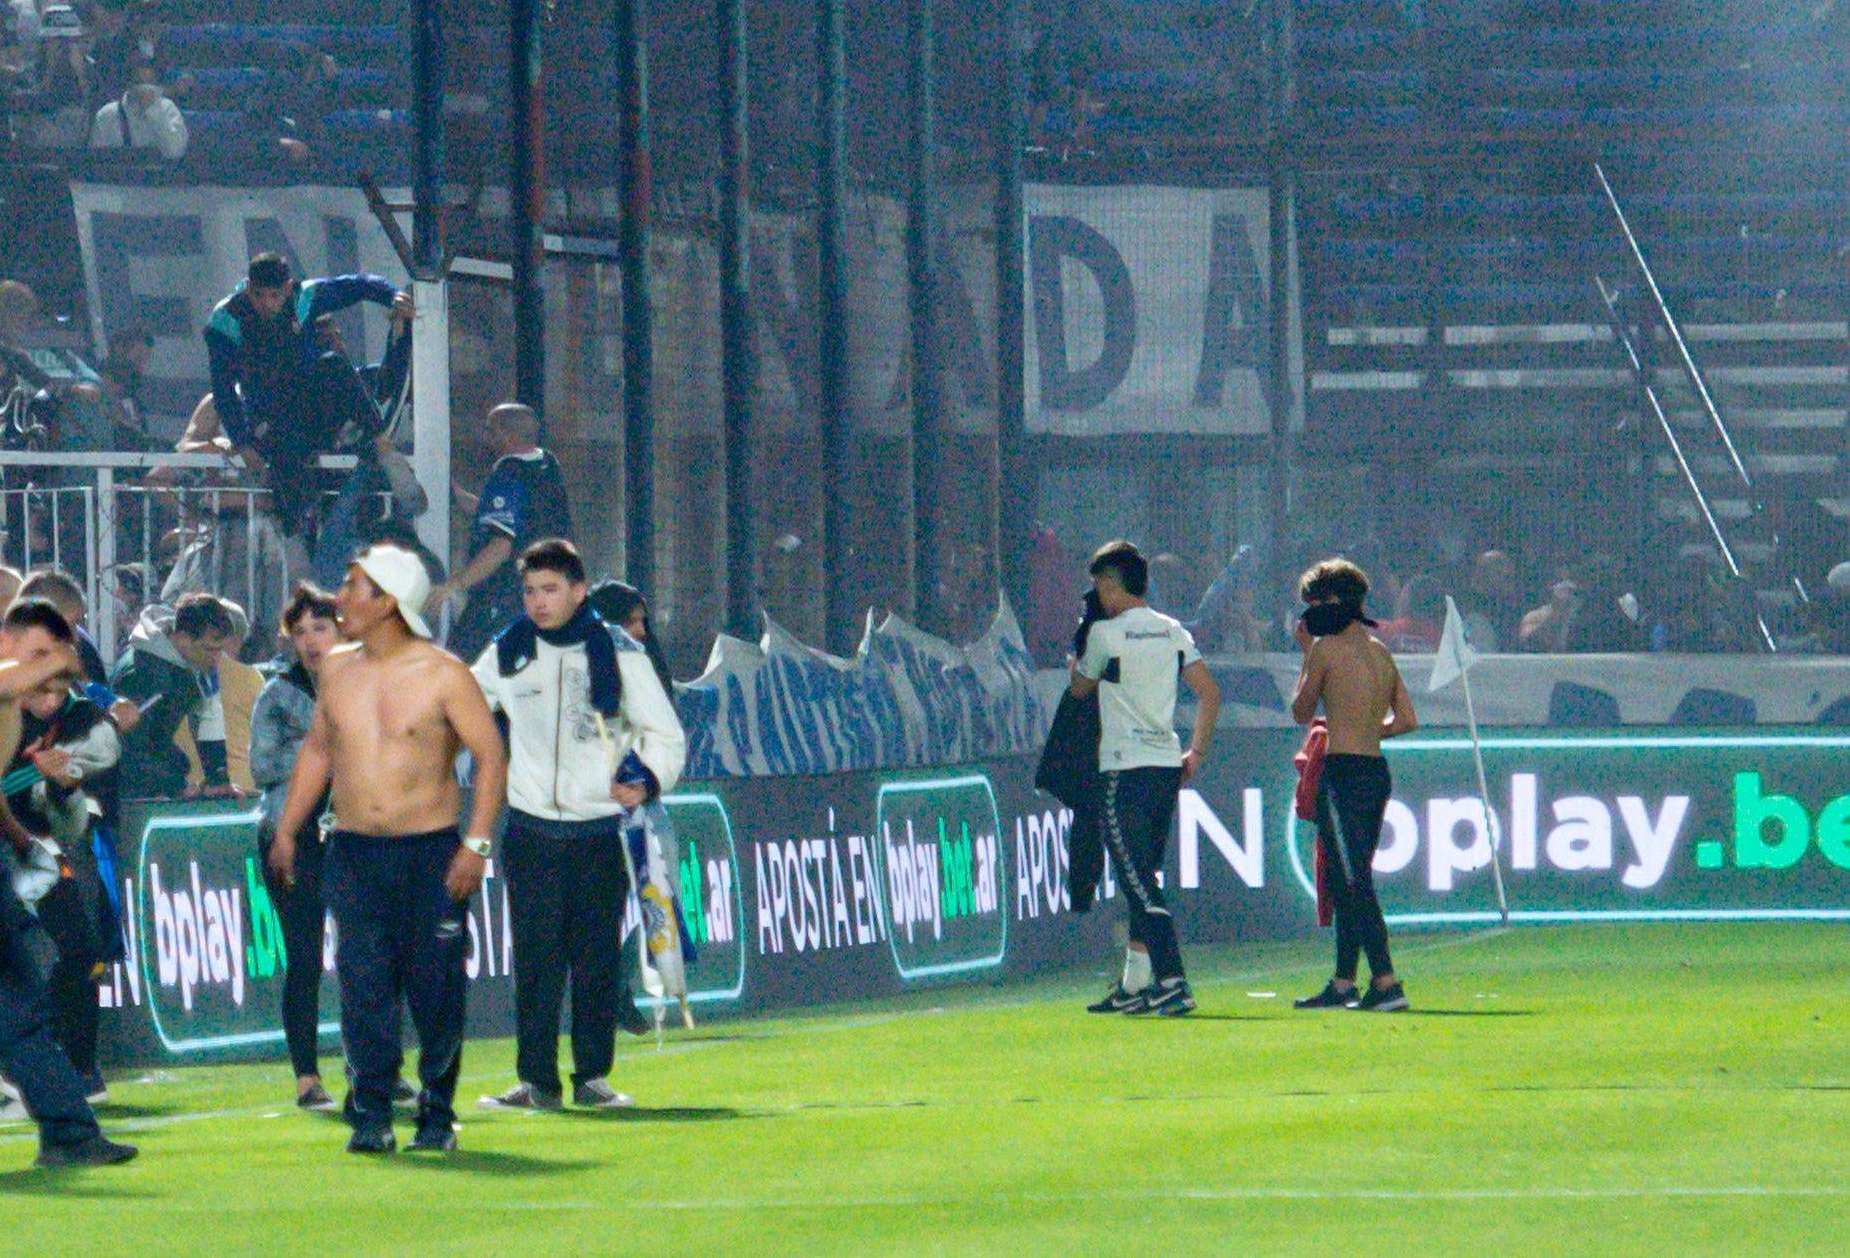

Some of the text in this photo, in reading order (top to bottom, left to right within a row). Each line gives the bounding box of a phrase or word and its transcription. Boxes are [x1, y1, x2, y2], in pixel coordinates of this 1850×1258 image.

[754, 808, 853, 955] APOSTÁ
[848, 835, 887, 947] EN
[883, 816, 999, 944] bplay.bet.ar
[1016, 808, 1075, 921] APOS
[1155, 788, 1264, 890] N
